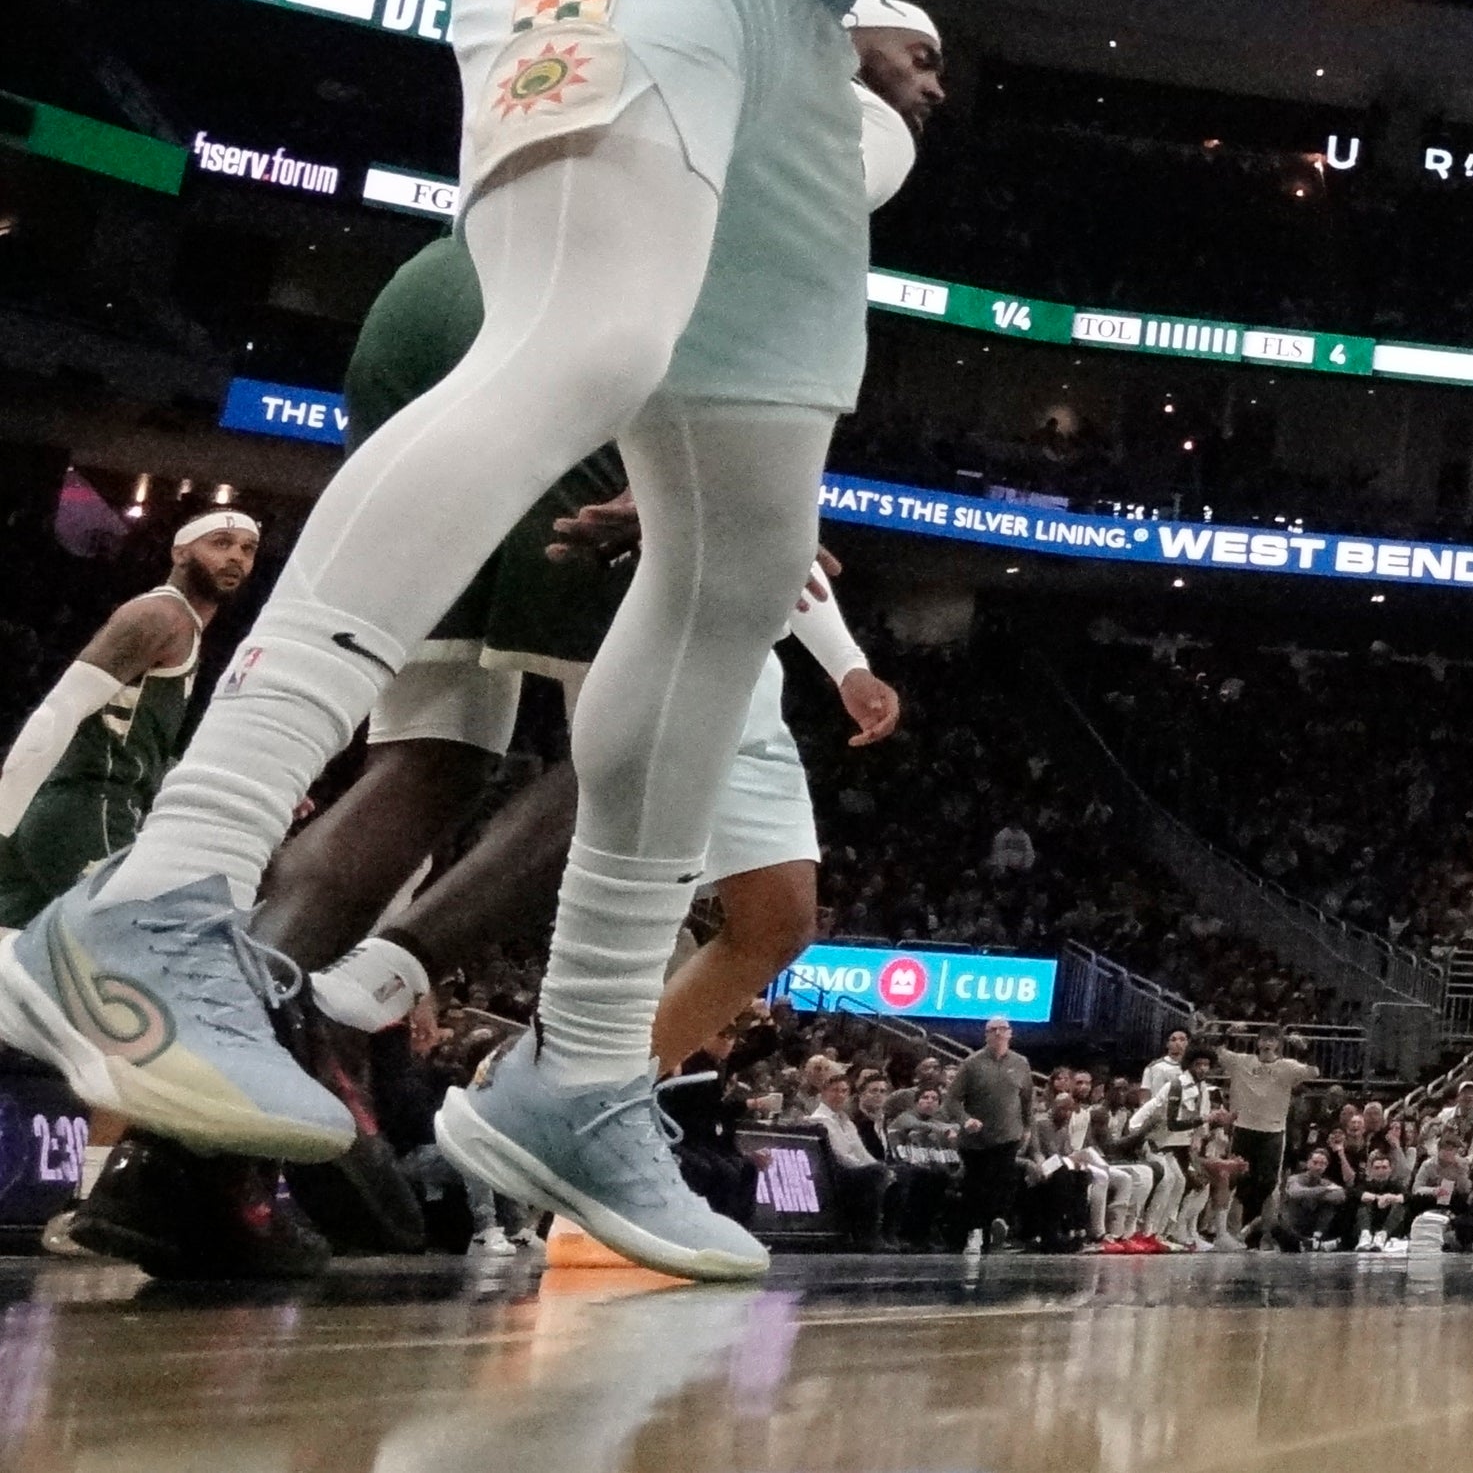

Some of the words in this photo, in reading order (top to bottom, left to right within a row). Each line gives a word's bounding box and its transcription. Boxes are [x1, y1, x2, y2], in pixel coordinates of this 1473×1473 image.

[411, 182, 455, 210] FG
[899, 282, 935, 308] FT
[991, 300, 1032, 332] 1/4
[1080, 315, 1133, 342] TOL
[1262, 336, 1304, 359] FLS
[1328, 342, 1347, 366] 4
[261, 395, 327, 429] THE
[818, 484, 894, 517] HAT'S
[897, 497, 948, 525] THE
[953, 506, 1030, 539] SILVER
[1158, 526, 1326, 569] WEST
[789, 963, 872, 994] BMO
[954, 972, 1039, 1004] CLUB
